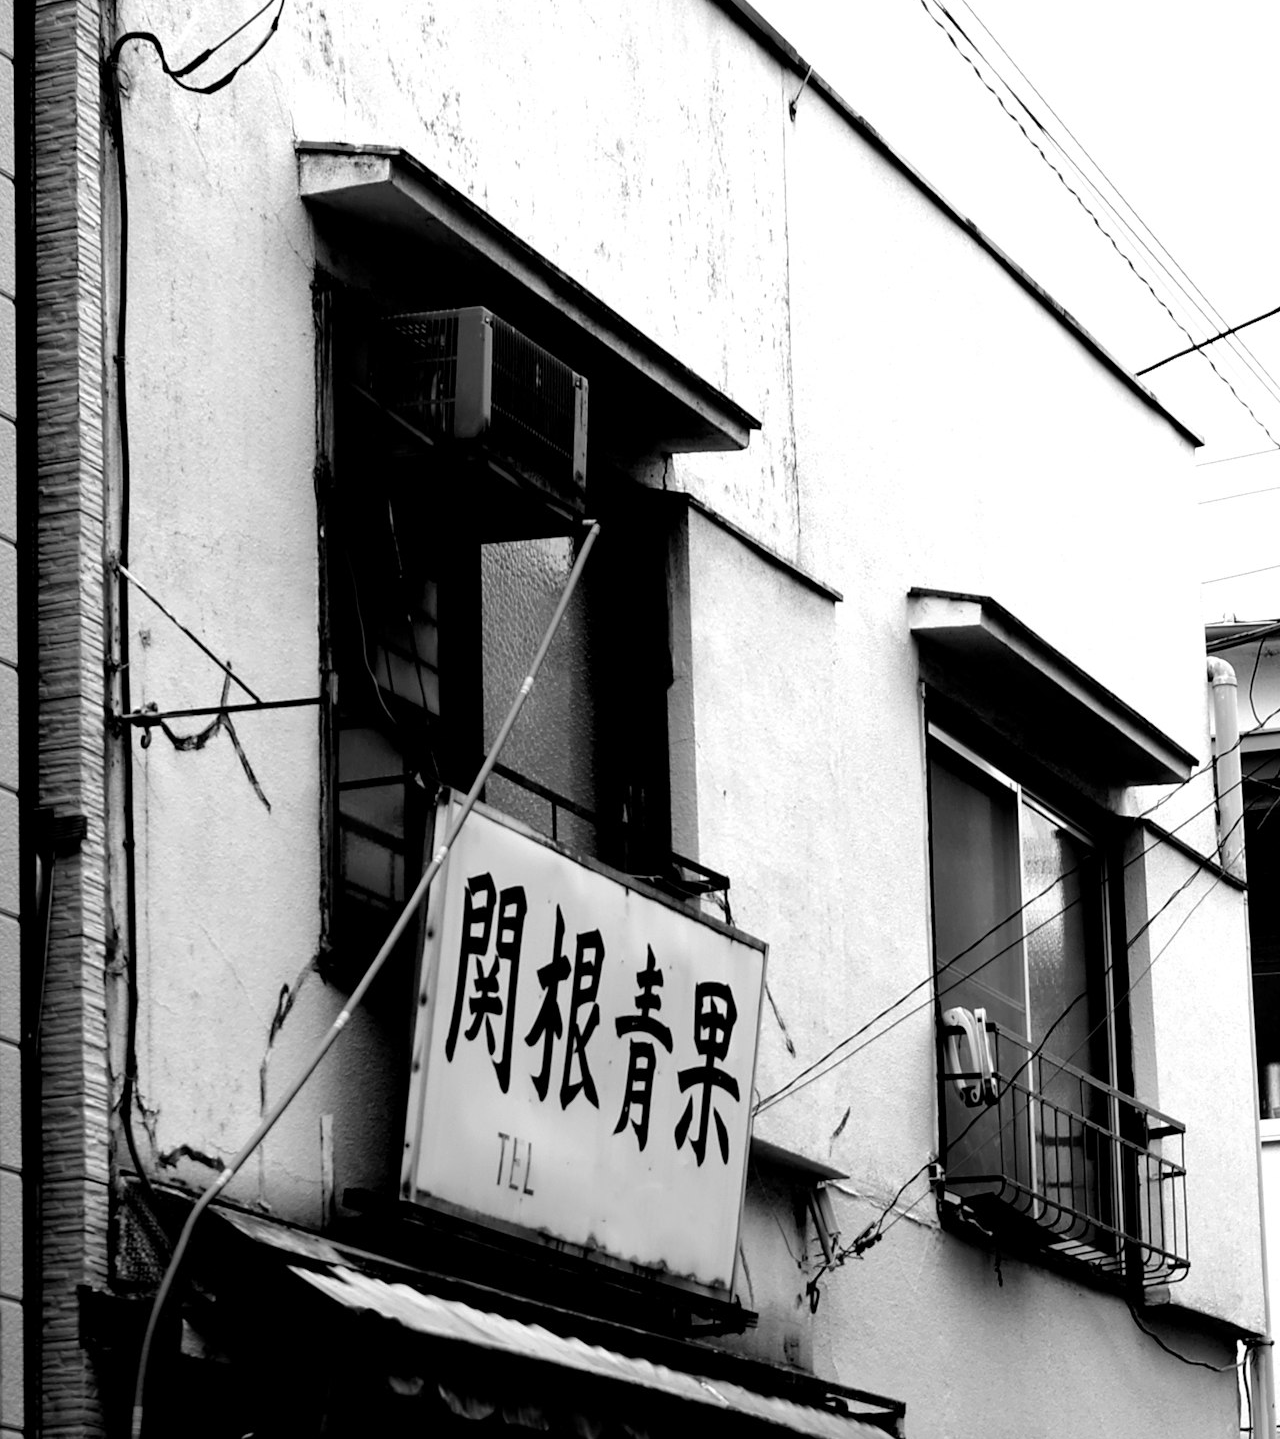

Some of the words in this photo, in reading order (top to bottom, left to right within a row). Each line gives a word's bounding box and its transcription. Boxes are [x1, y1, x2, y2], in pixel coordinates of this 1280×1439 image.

[444, 871, 741, 1167] 関根青果
[496, 1131, 534, 1197] TEL
